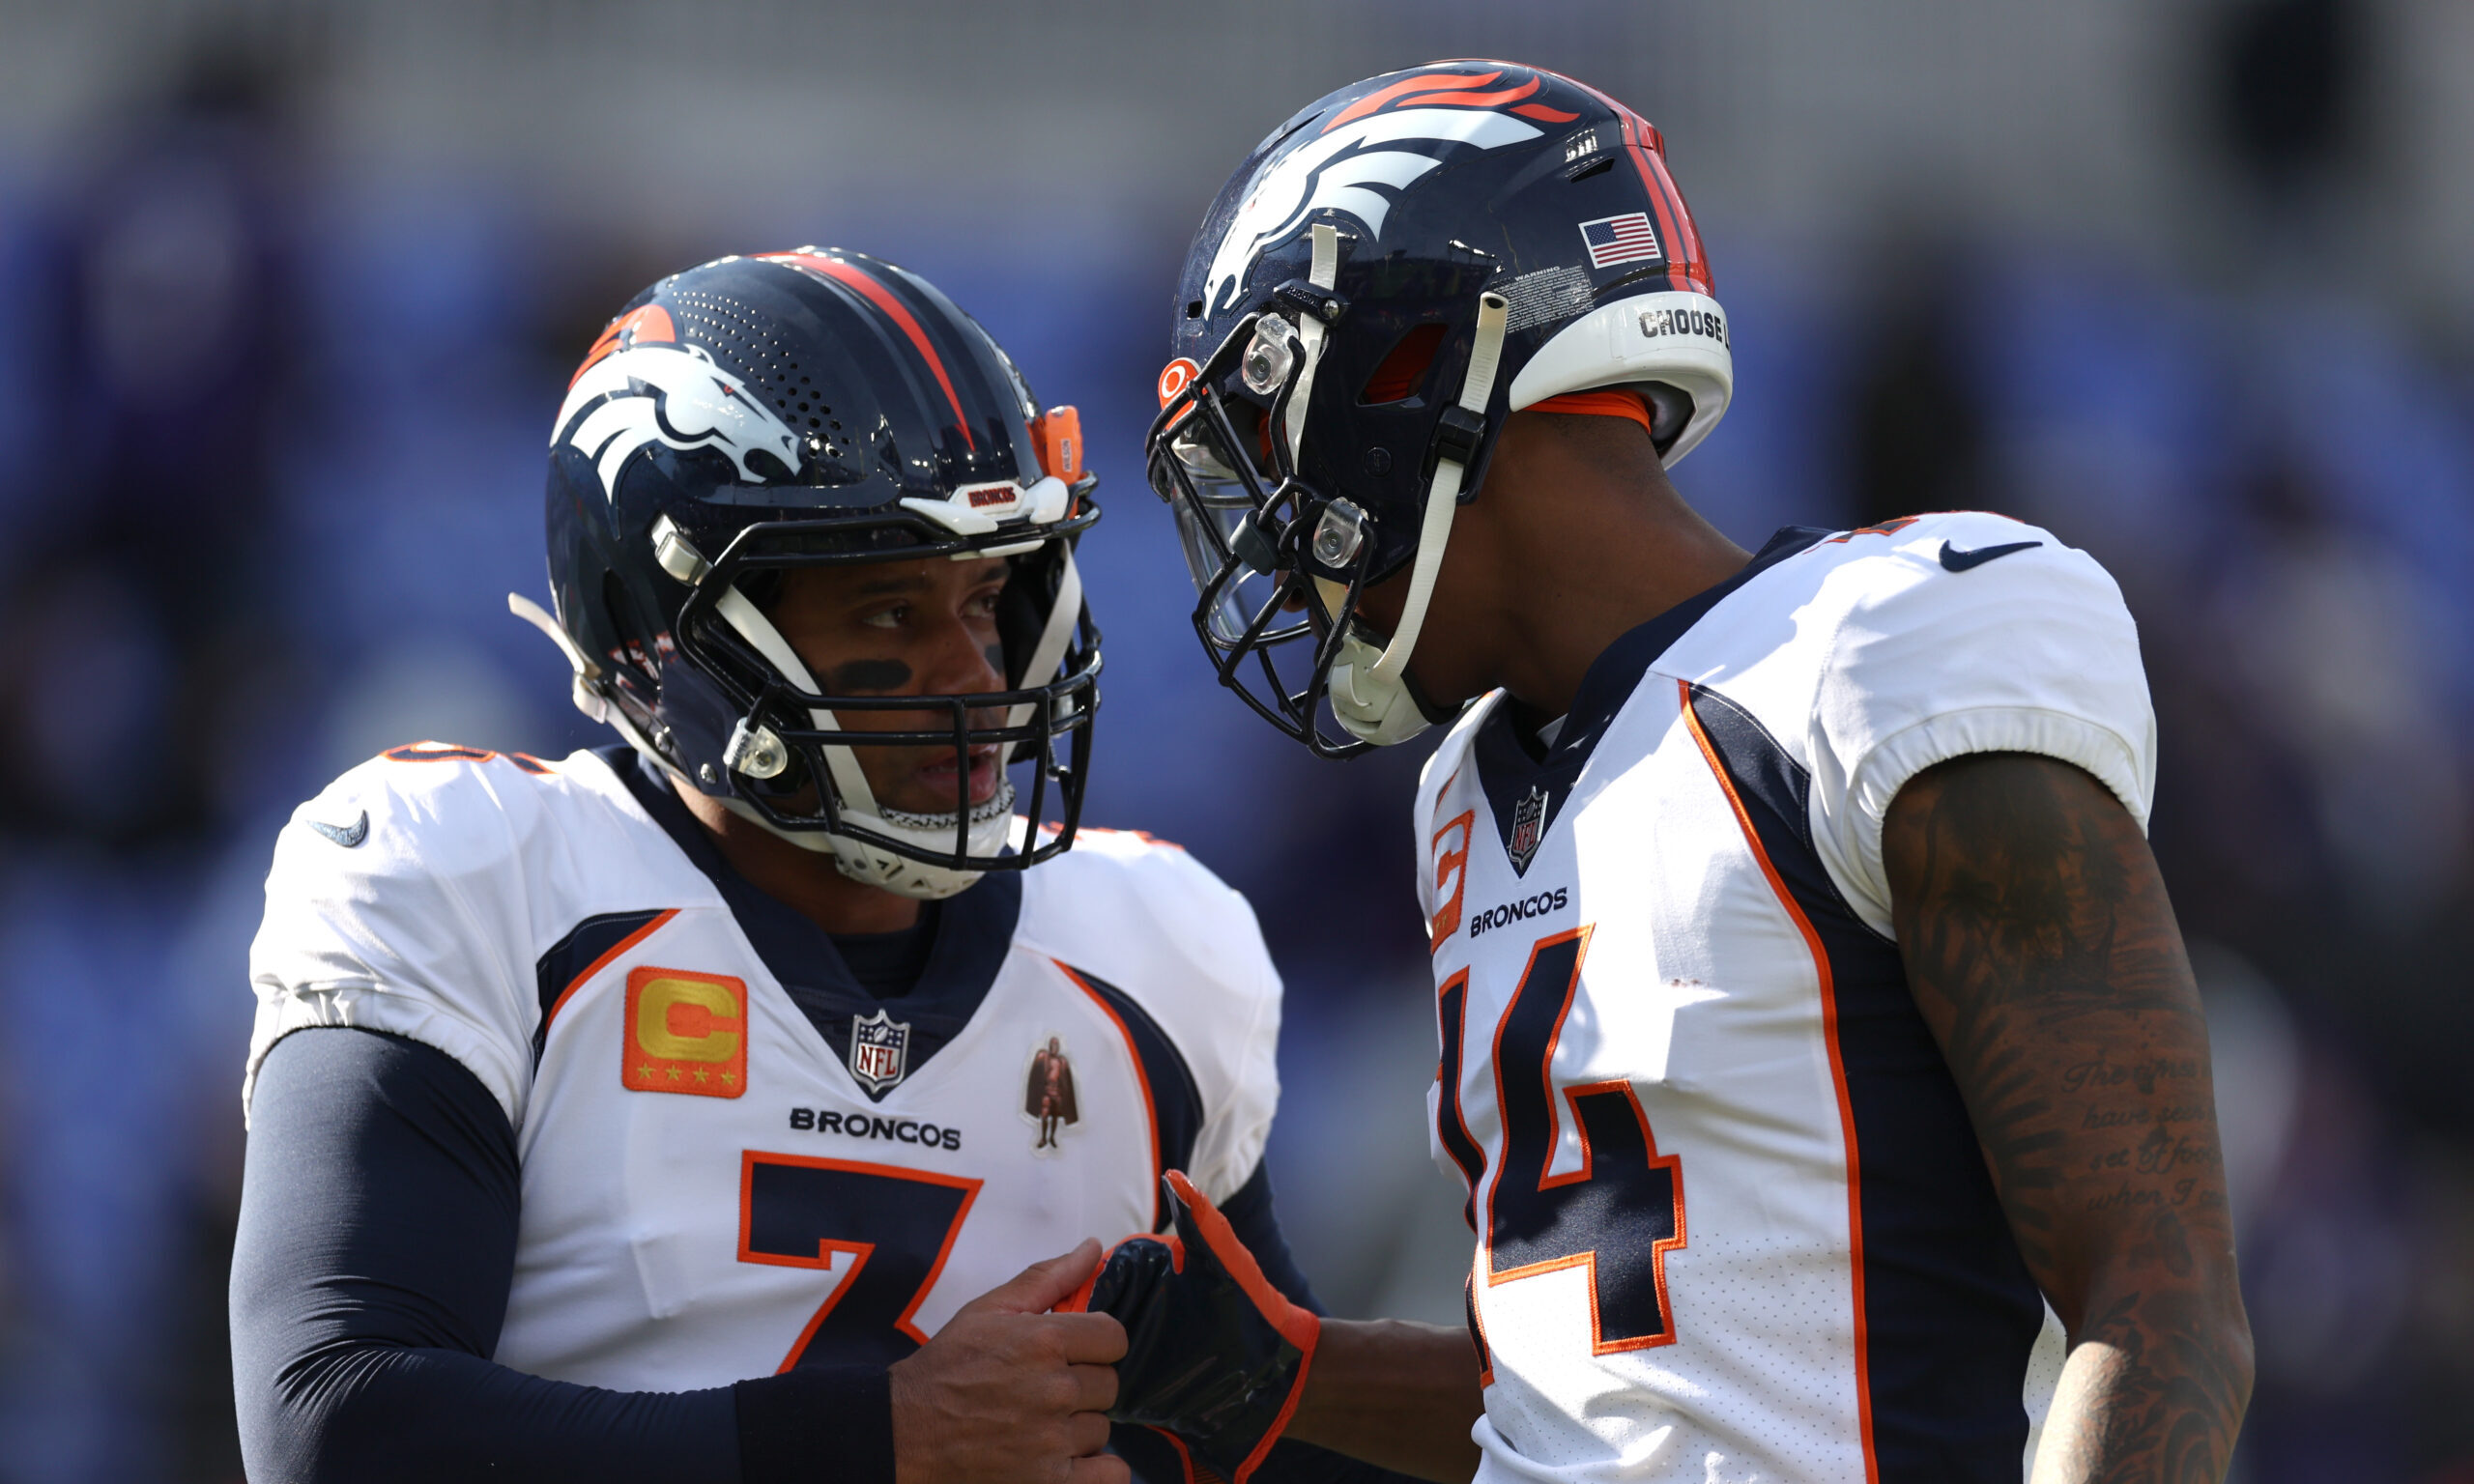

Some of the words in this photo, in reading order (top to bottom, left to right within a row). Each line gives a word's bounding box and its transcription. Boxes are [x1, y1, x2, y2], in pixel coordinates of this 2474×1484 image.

[1514, 266, 1561, 282] WARNING
[1639, 308, 1723, 343] CHOOSE
[967, 486, 1017, 508] BRONCOS
[1513, 821, 1537, 852] NFL
[1470, 886, 1568, 939] BRONCOS
[637, 978, 739, 1063] C
[859, 1043, 897, 1076] NFL
[789, 1107, 962, 1151] BRONCOS
